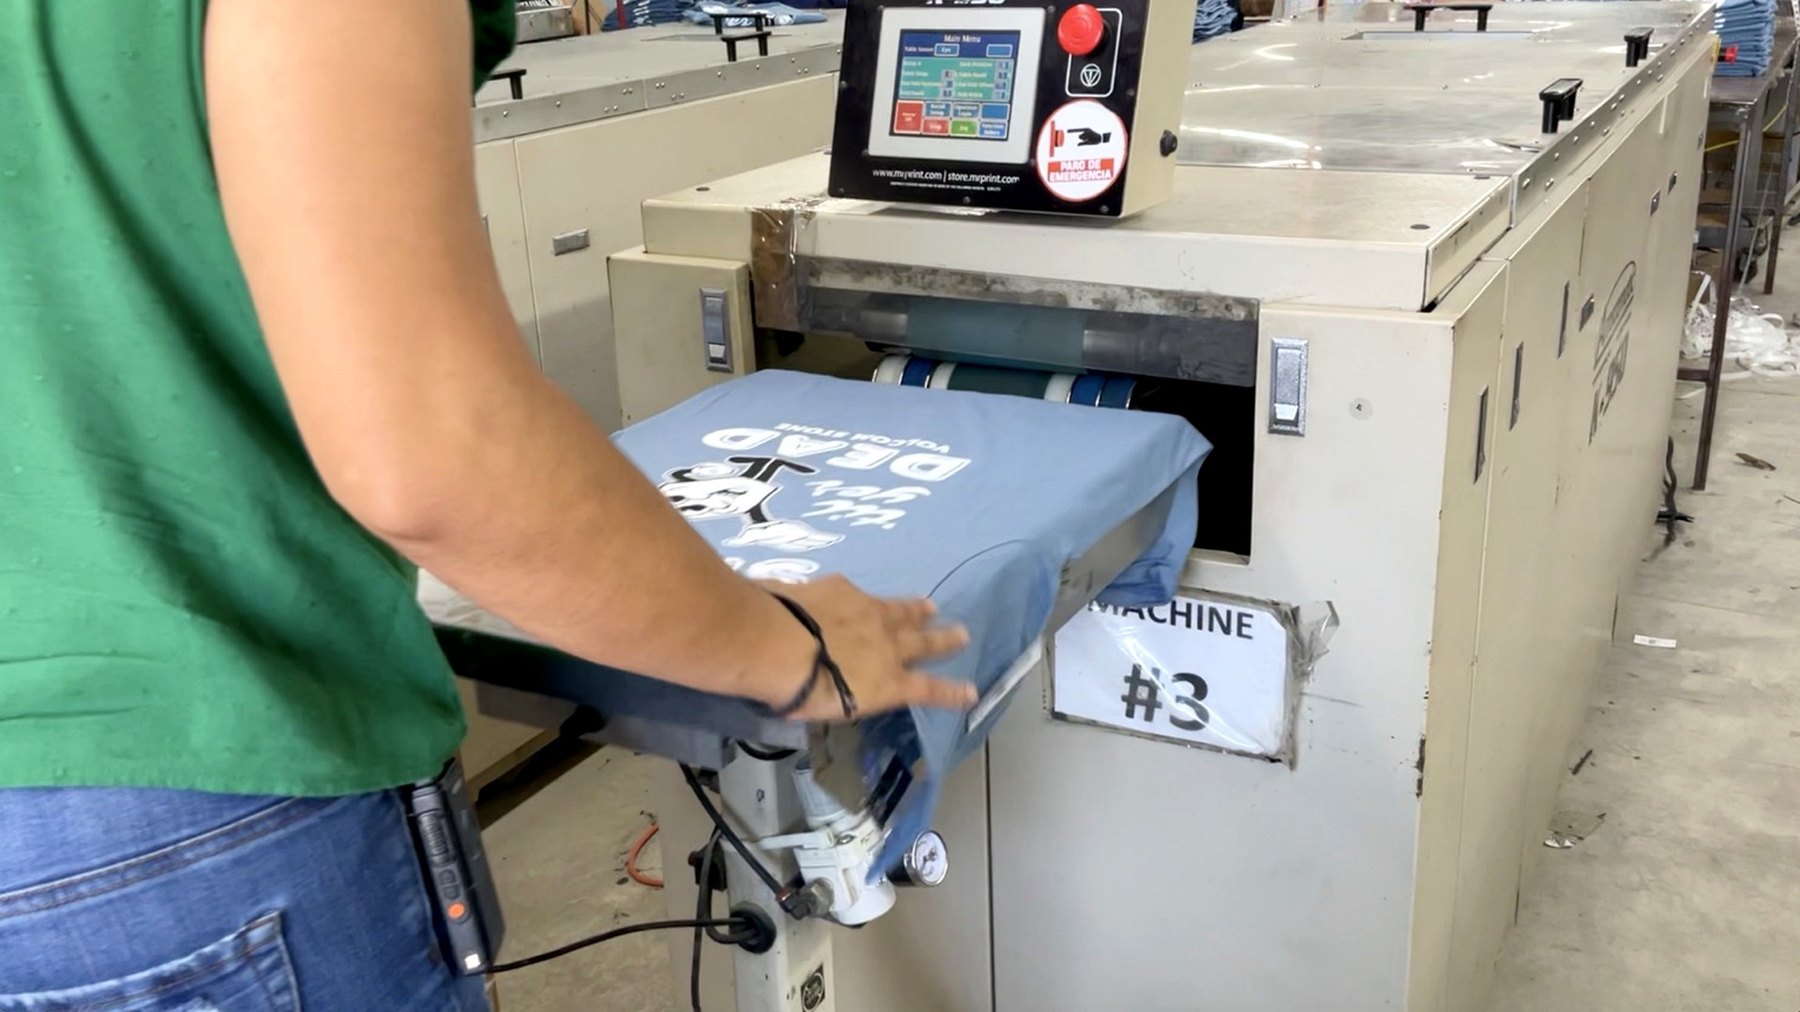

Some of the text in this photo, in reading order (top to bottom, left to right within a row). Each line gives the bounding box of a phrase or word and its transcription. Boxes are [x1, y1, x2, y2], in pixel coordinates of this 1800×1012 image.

[943, 34, 981, 43] Main Menu
[1060, 159, 1101, 171] PARO DE
[1049, 169, 1112, 181] EMERGENCIA
[849, 432, 952, 454] VOLCOM
[701, 426, 972, 482] DEAD
[1121, 663, 1210, 731] #3
